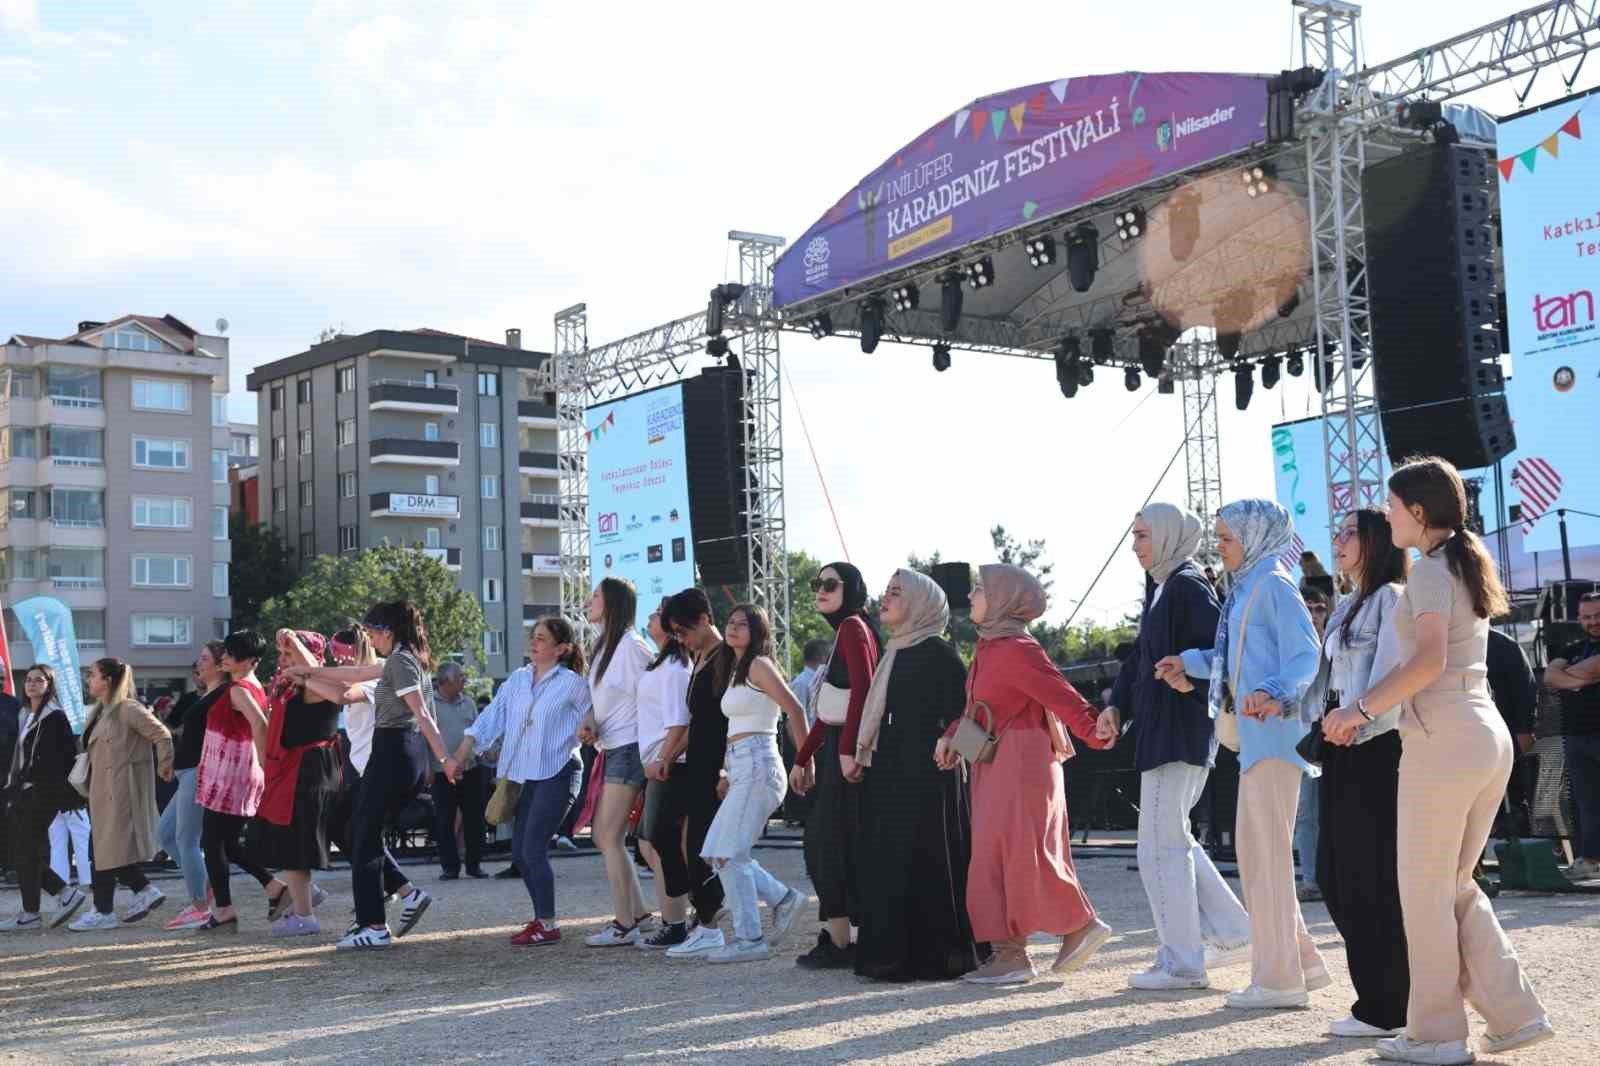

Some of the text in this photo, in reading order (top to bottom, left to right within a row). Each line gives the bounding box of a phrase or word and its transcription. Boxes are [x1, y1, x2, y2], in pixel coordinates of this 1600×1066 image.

[1175, 106, 1235, 138] Nilsader
[887, 159, 1000, 238] KARADENİZ
[1004, 96, 1121, 184] FESTİVALİ
[1533, 290, 1594, 332] tan
